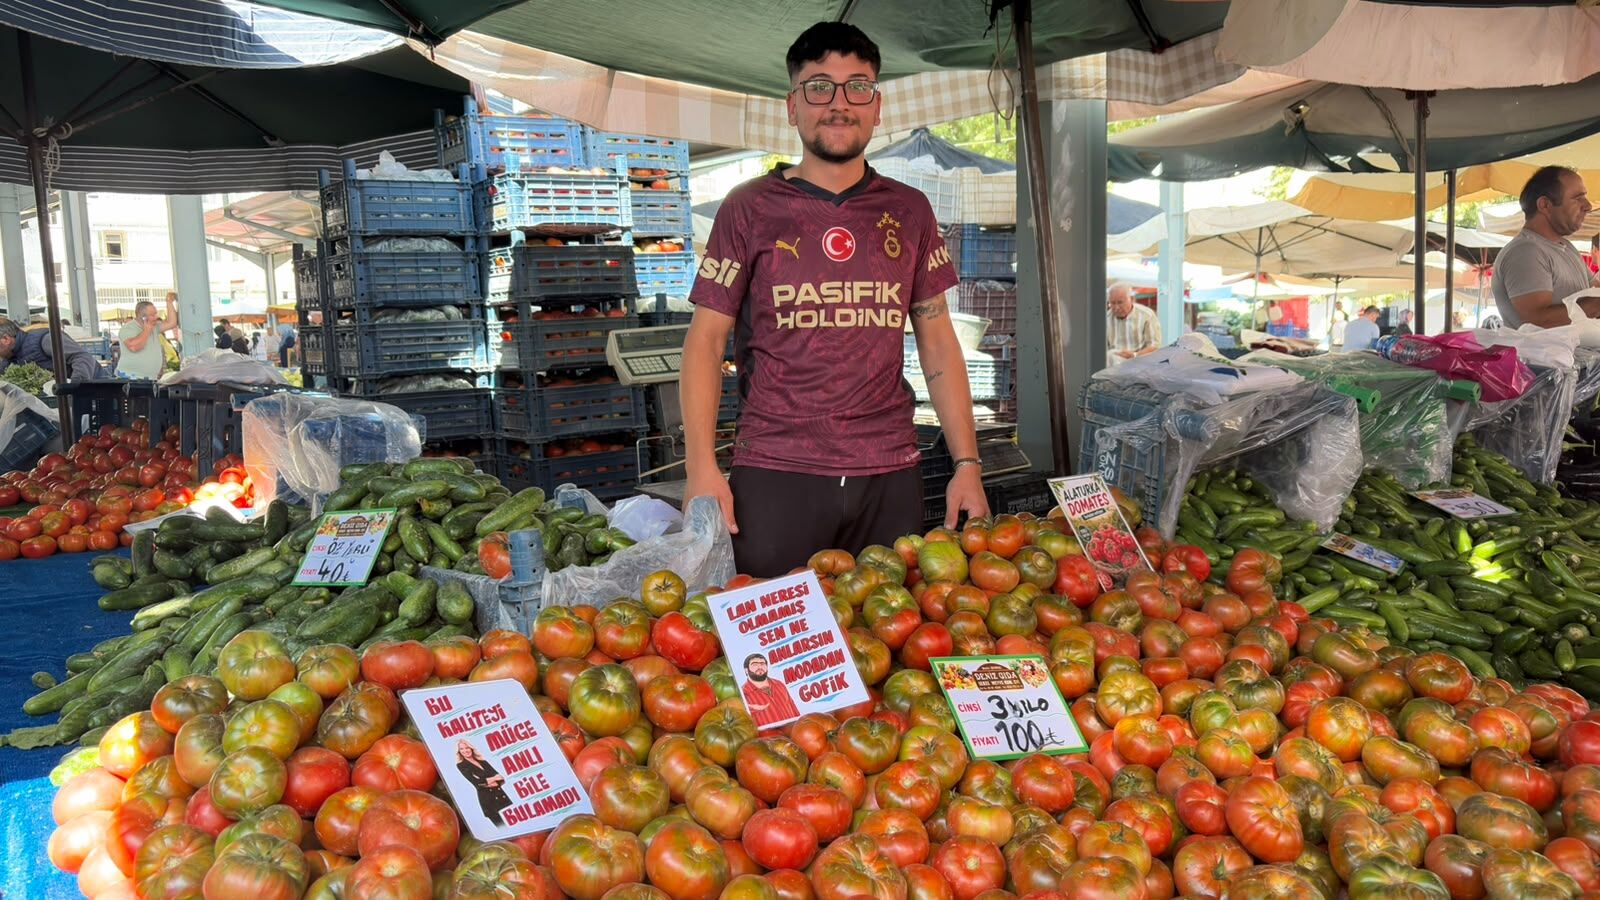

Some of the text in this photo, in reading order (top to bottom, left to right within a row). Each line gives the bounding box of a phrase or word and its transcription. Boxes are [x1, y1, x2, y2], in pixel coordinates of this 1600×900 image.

[1063, 482, 1100, 502] ALATURKA
[1067, 493, 1110, 516] DOMATES
[726, 581, 810, 621] LAN NERESİ
[738, 600, 806, 634] OLMAMIŞ
[758, 618, 809, 646] SEN NE
[768, 630, 834, 665] ANLARSIN
[783, 648, 845, 684] MODADAN
[799, 672, 849, 703] GOFİK
[424, 695, 453, 716] BU
[957, 701, 982, 713] CİNSİ
[987, 695, 1009, 719] 3
[437, 704, 507, 738] KALİTEYİ
[485, 720, 538, 752] MÜGE
[972, 735, 999, 747] FİYATI
[501, 746, 544, 775] ANLI
[513, 772, 550, 799] BİLE
[502, 786, 582, 827] BULAMADI
